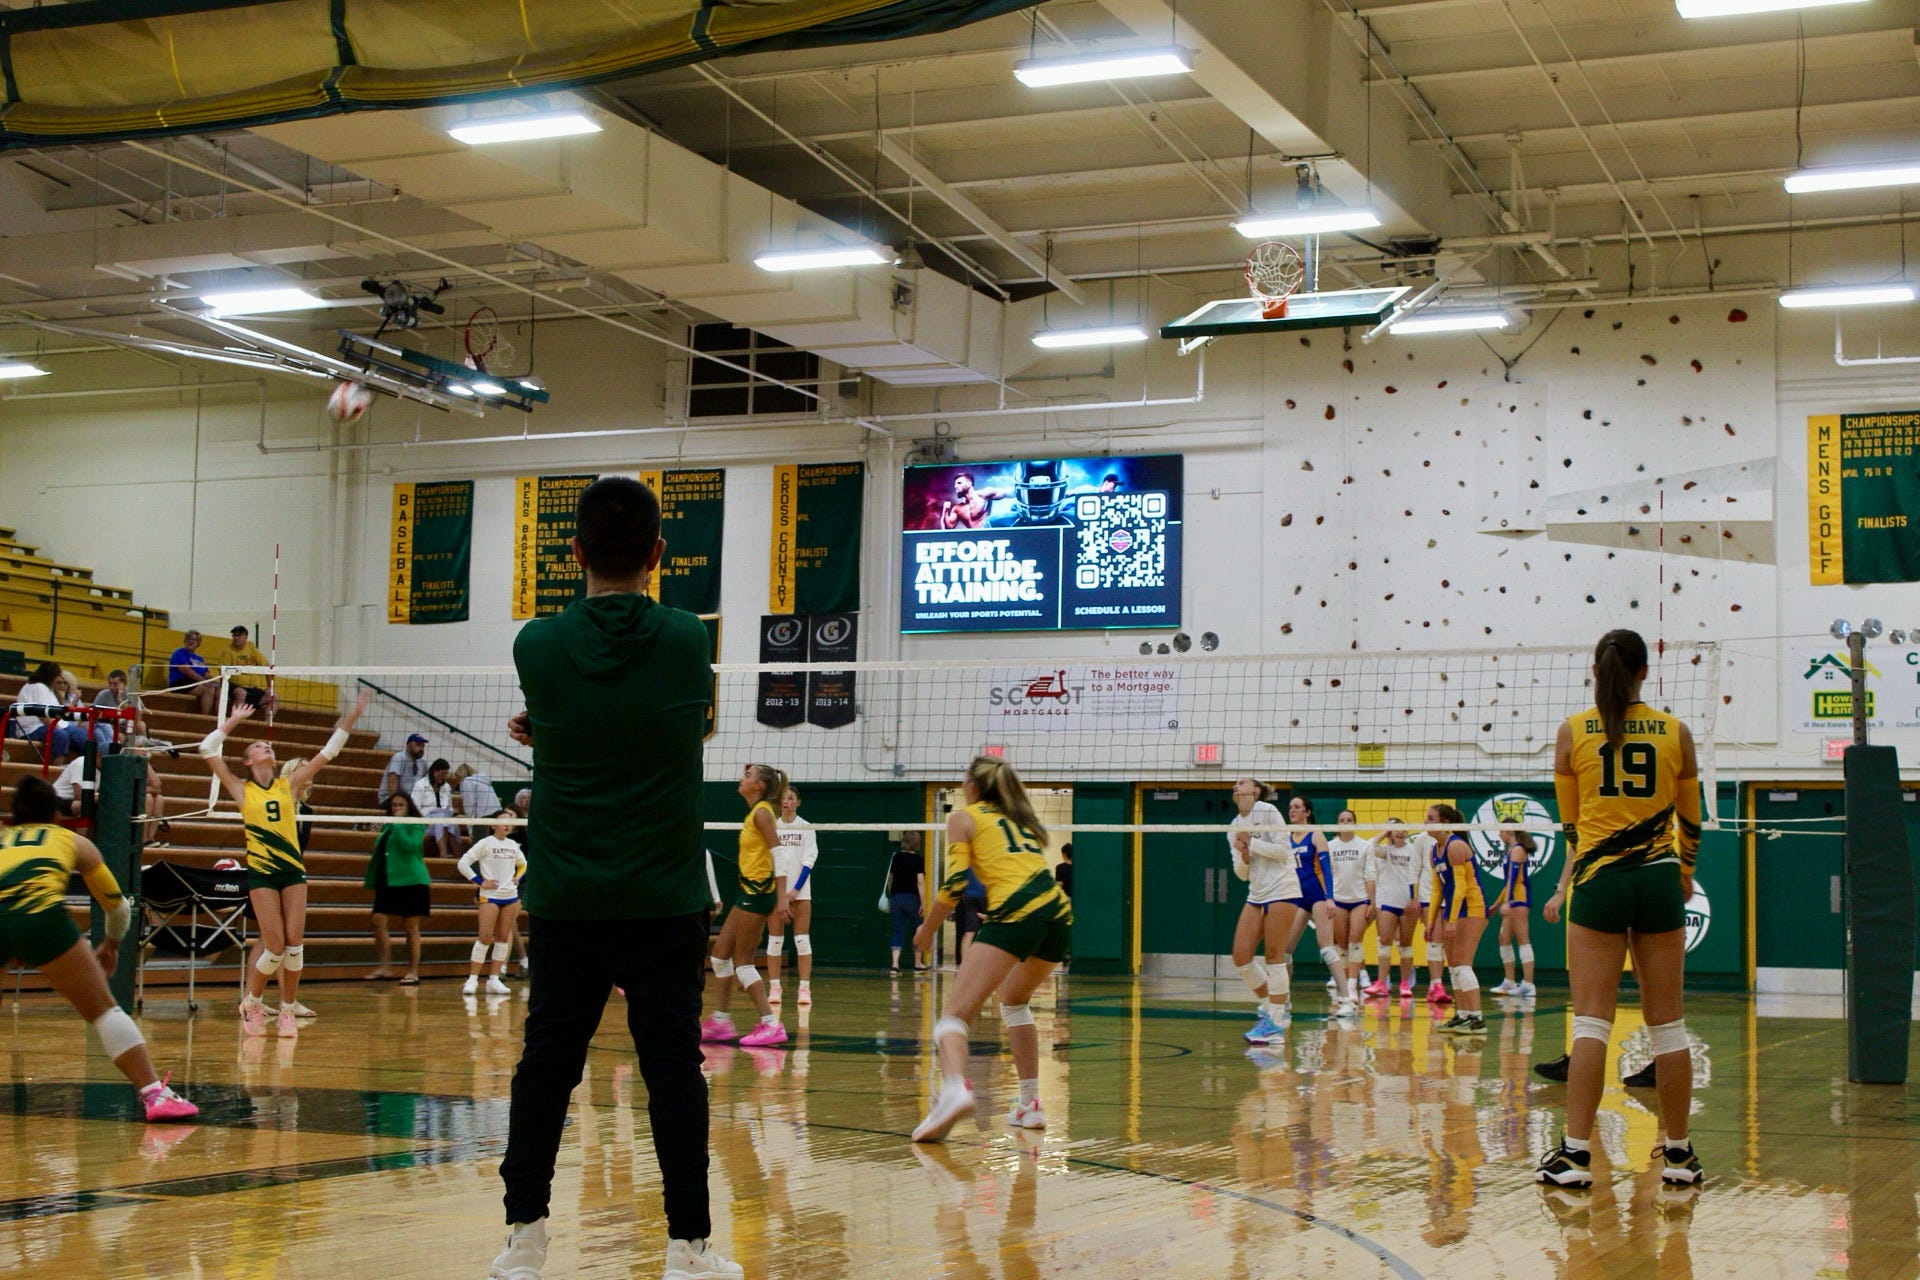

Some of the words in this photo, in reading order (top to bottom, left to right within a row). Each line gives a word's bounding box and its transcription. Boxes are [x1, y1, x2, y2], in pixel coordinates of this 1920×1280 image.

[1846, 415, 1920, 429] CHAMPIONSHIPS
[1818, 426, 1830, 494] MENS
[666, 472, 720, 483] CHAMPIONSHIPS
[800, 466, 860, 478] CHAMPIONSHIPS
[523, 482, 531, 518] MENS
[780, 473, 789, 526] CROSS
[1858, 516, 1907, 529] FINALISTS
[1820, 505, 1831, 574] GOLF
[395, 494, 408, 617] BASEBALL
[796, 547, 828, 557] FINALISTS
[916, 540, 1013, 563] EFFORT.
[546, 563, 582, 572] FINALISTS
[672, 556, 708, 567] FINALISTS
[520, 525, 530, 614] BASKETBALL
[778, 532, 788, 607] COUNTRY
[915, 560, 1043, 584] ATTITUDE.
[915, 580, 1043, 605] TRAINING.
[916, 612, 948, 620] UNLEASH
[1000, 610, 1042, 618] POTENTIAL.
[1075, 606, 1120, 616] SCHEDULE
[1121, 606, 1129, 615] A
[1131, 605, 1165, 614] LESSON
[1091, 670, 1110, 679] The
[1115, 670, 1148, 679] better
[1153, 671, 1175, 681] way
[1091, 683, 1102, 692] to
[1117, 682, 1173, 694] Mortgage.
[765, 698, 783, 706] 2012
[791, 698, 800, 706] 13
[816, 698, 832, 707] 2013
[839, 698, 849, 706] 14
[1585, 719, 1667, 735] BLKHAWK
[1198, 745, 1219, 761] EXIT
[1598, 741, 1657, 799] 19
[266, 799, 282, 822] 9
[214, 883, 240, 893] molten
